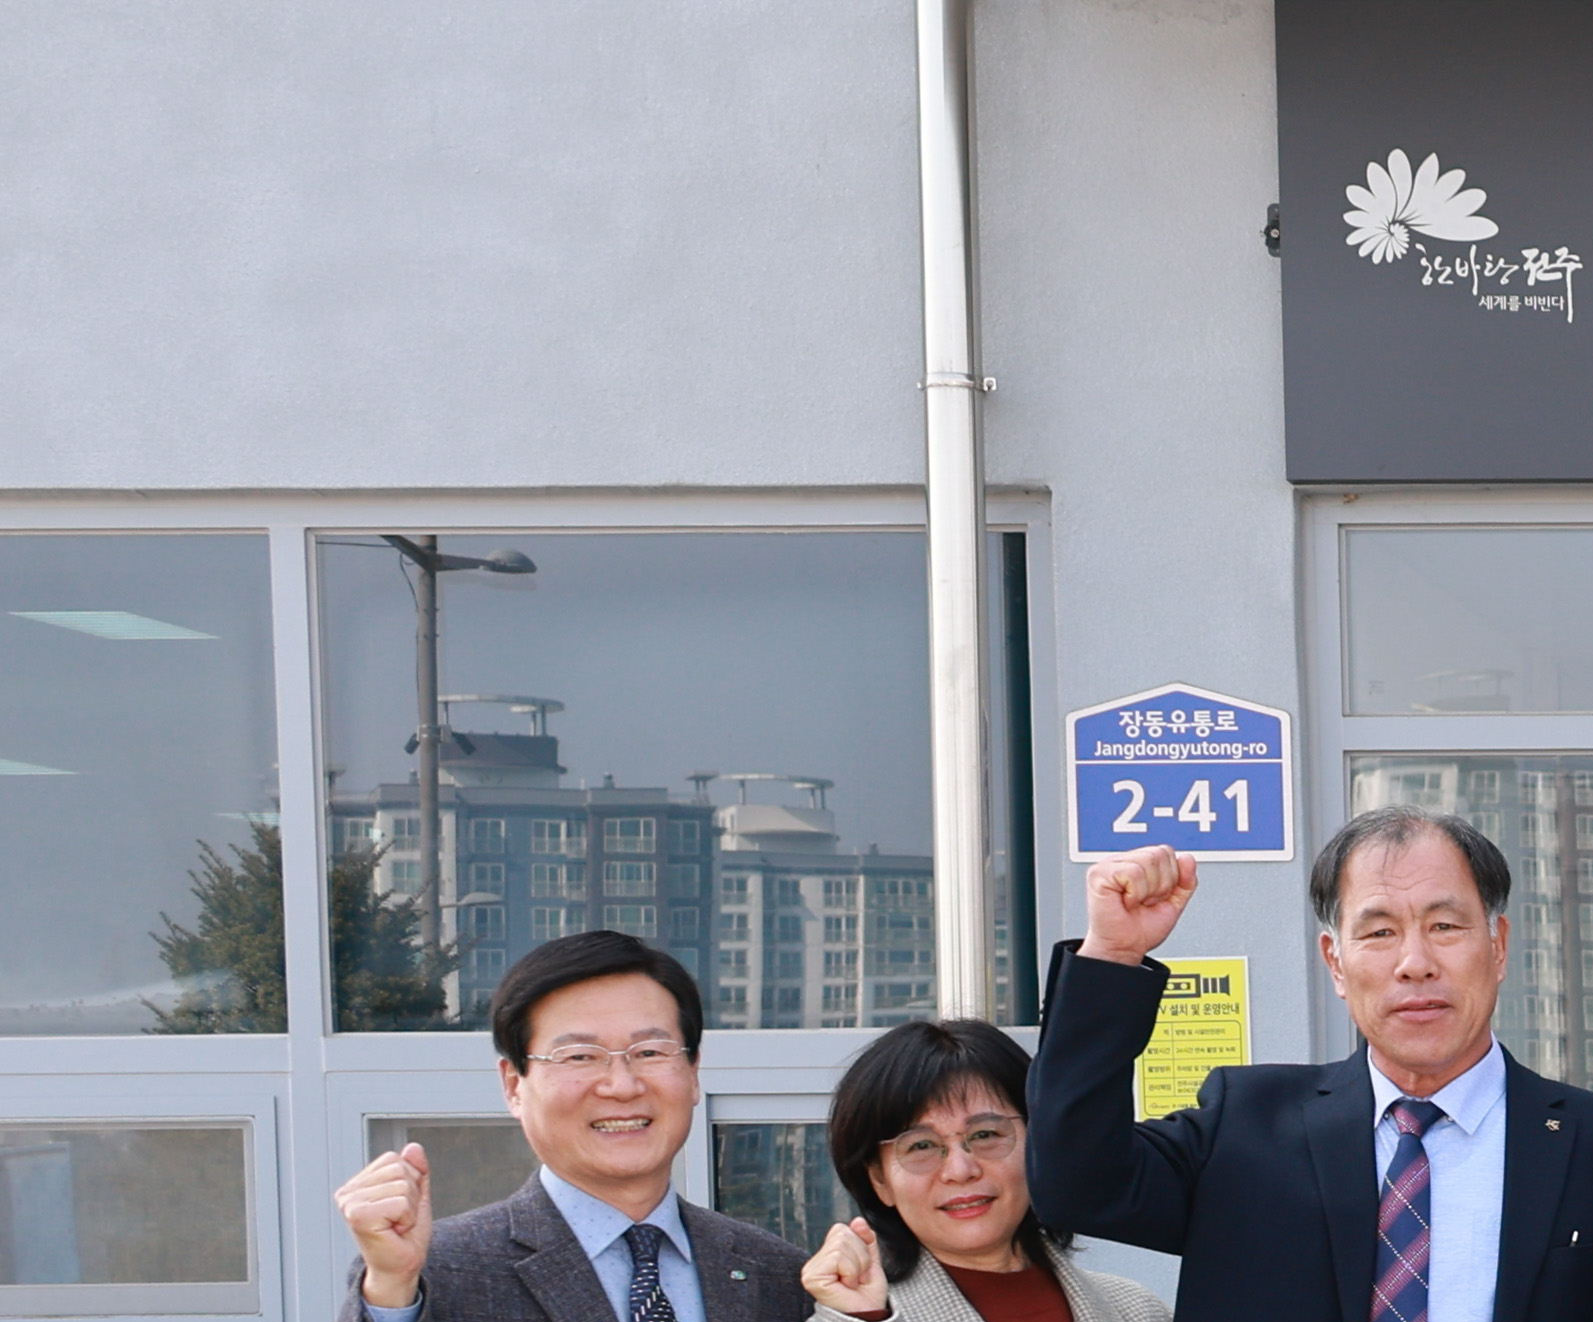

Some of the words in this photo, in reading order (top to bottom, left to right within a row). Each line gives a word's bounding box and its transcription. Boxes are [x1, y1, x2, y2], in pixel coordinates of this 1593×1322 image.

[1479, 295, 1521, 312] 세계를
[1524, 295, 1565, 312] 비빈다
[1118, 710, 1239, 738] 장동유통로
[1094, 740, 1268, 760] Jangdongyutong-ro
[1112, 779, 1249, 833] 2-41
[1170, 1003, 1189, 1017] 설치
[1191, 1003, 1201, 1016] 및
[1203, 1002, 1240, 1016] 운영안내
